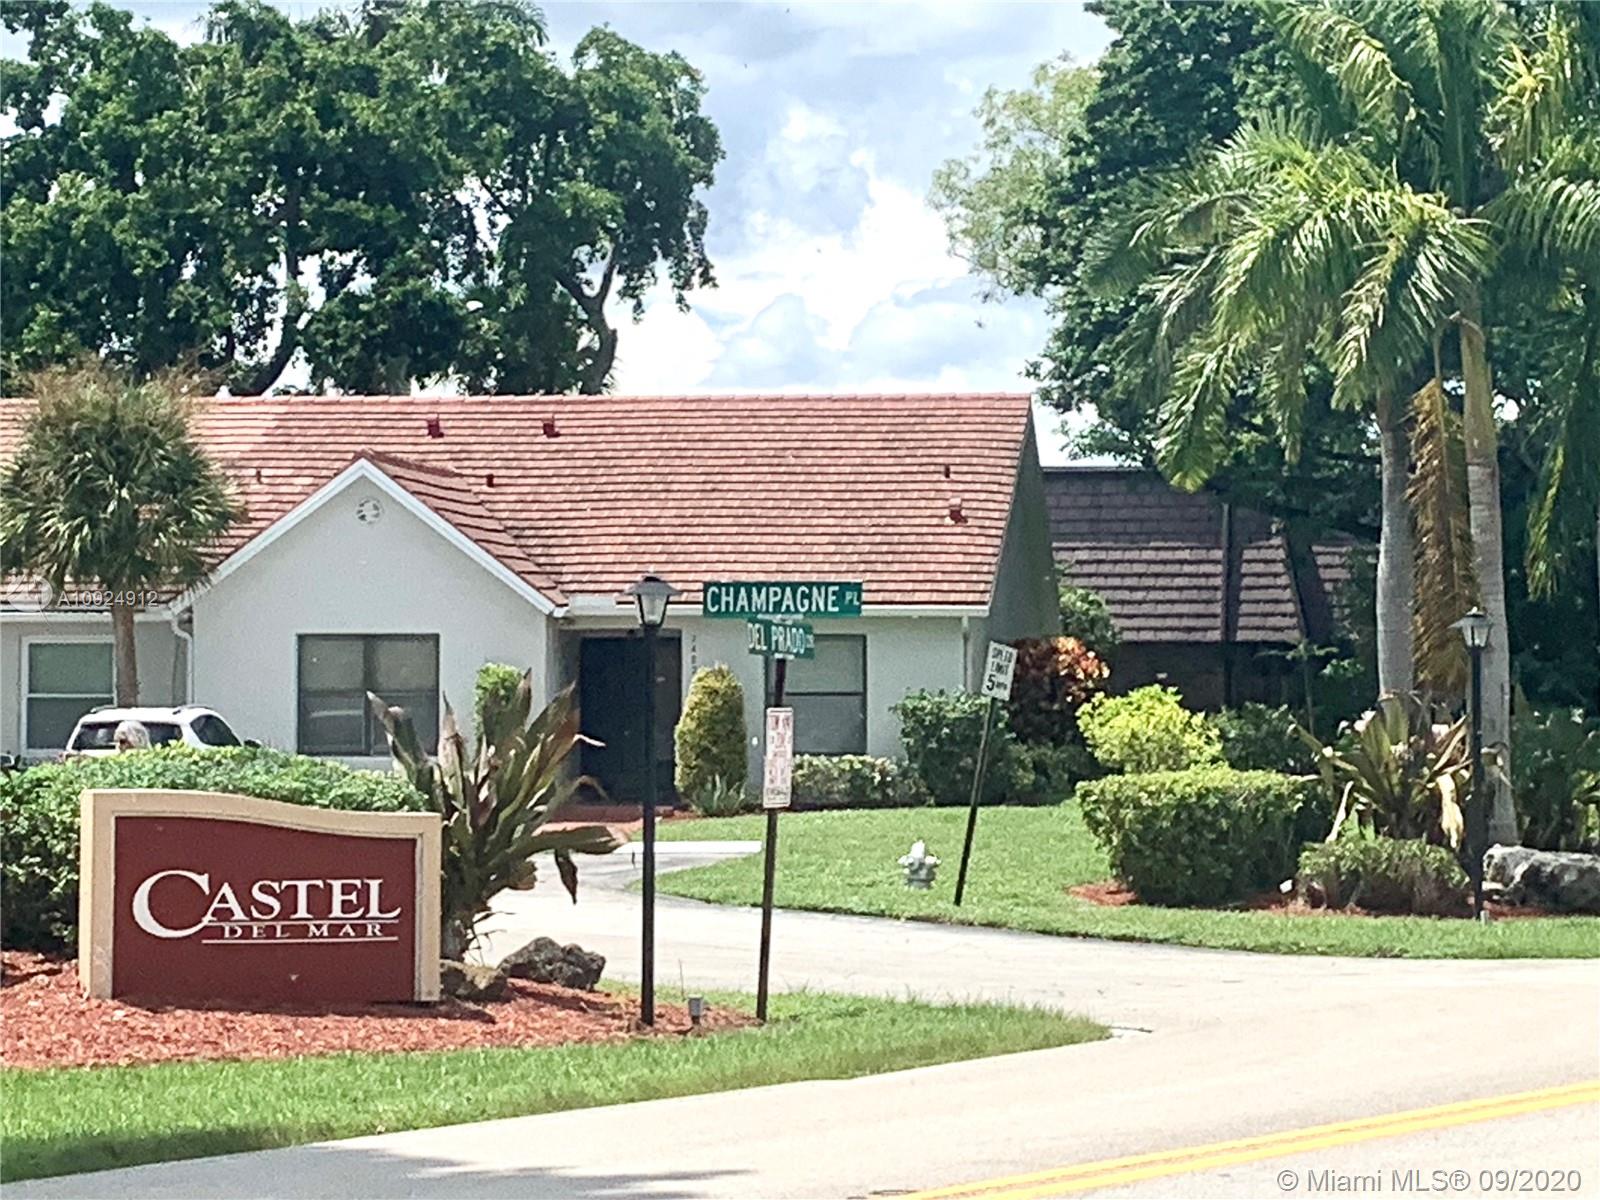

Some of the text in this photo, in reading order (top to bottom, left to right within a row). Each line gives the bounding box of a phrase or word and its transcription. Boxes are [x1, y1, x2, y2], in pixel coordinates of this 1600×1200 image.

[706, 586, 860, 612] CHAMPAGNE PL
[747, 623, 768, 650] DEL
[771, 625, 805, 654] PRADO
[986, 673, 996, 691] 5
[132, 870, 401, 938] CASTEL
[224, 923, 384, 938] DEL MAR
